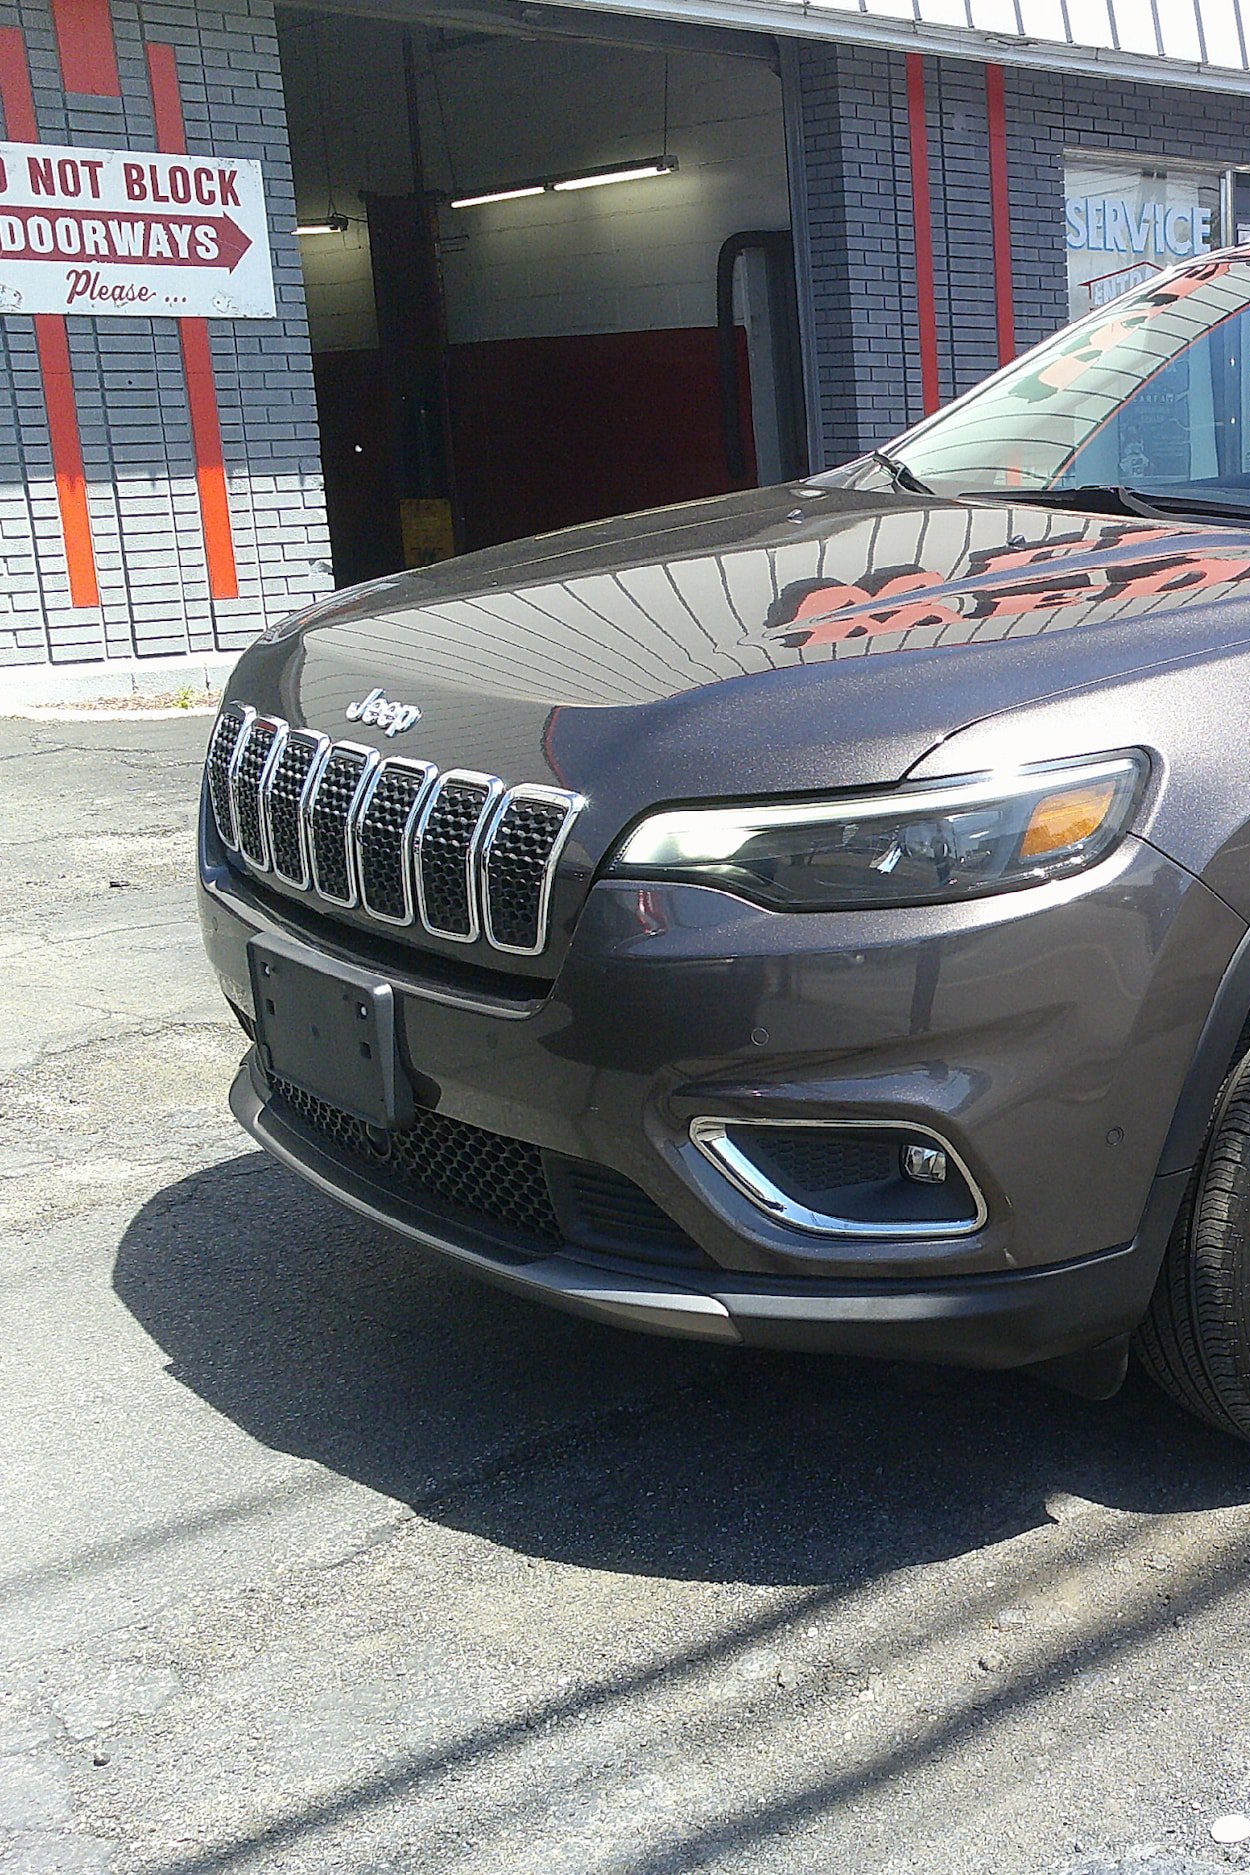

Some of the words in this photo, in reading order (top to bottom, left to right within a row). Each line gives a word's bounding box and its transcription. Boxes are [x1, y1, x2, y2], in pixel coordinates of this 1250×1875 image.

[27, 157, 103, 199] NOT
[123, 163, 241, 206] BLOCK
[1, 215, 219, 260] DOORWAYS
[1066, 199, 1211, 256] SERVICE
[66, 269, 156, 304] Please
[345, 688, 422, 738] Jeep
